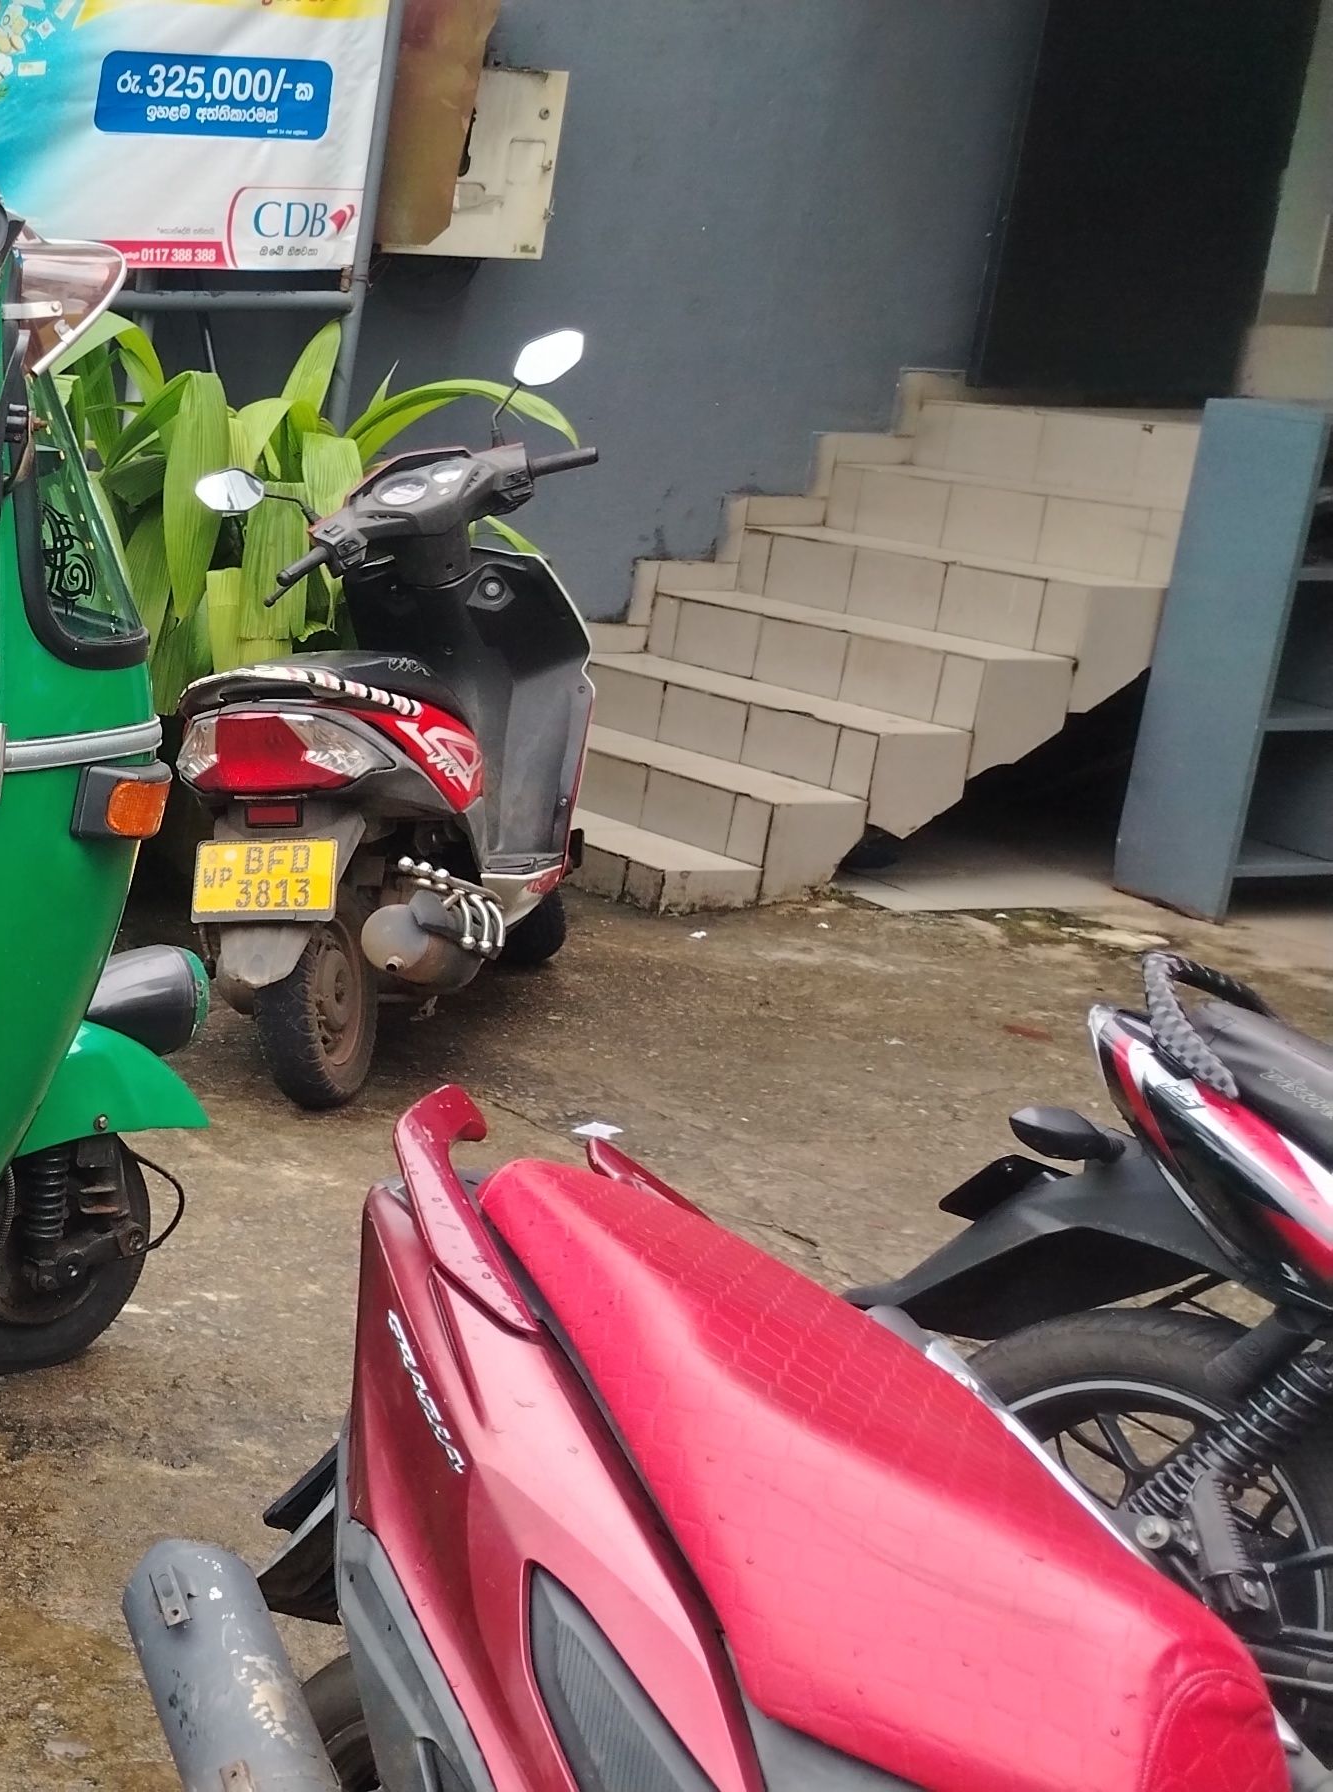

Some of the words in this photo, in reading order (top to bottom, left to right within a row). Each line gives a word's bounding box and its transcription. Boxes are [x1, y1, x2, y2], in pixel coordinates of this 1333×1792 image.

[253, 201, 328, 238] CDB
[141, 248, 170, 263] 0117
[171, 249, 192, 263] 388
[194, 249, 216, 263] 388
[245, 845, 311, 875] BFD
[203, 867, 233, 889] WP
[235, 878, 311, 908] 3813
